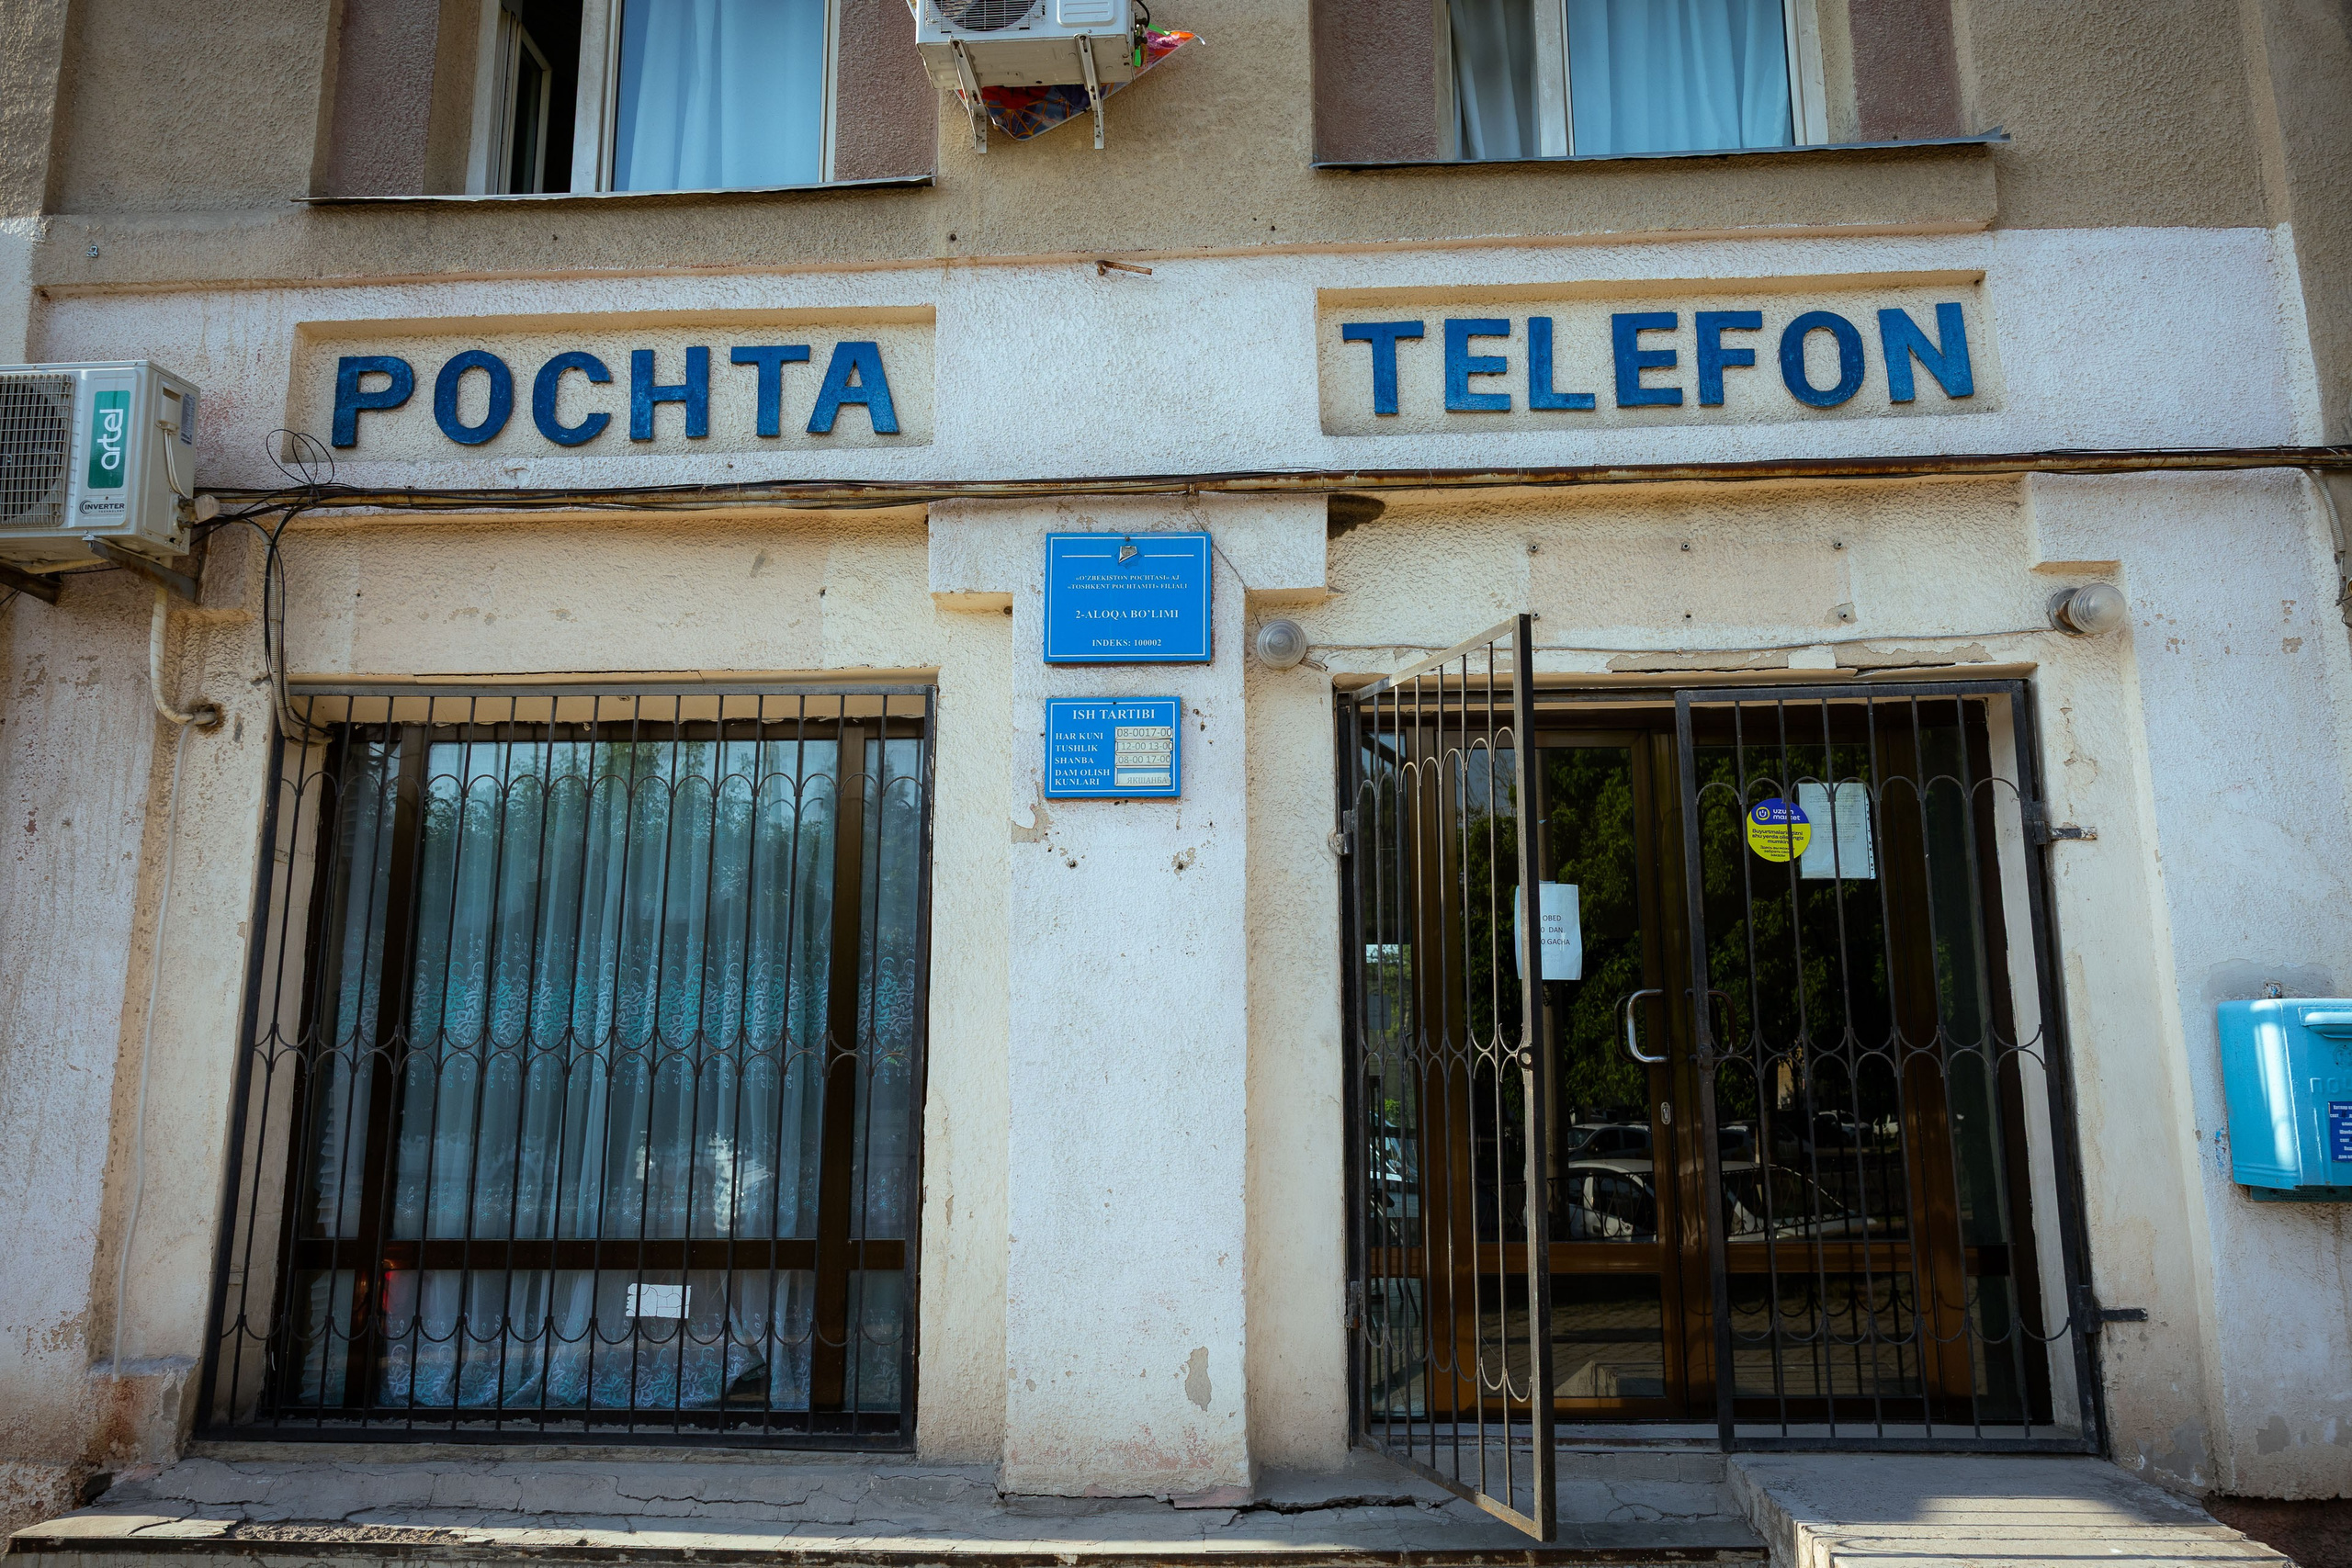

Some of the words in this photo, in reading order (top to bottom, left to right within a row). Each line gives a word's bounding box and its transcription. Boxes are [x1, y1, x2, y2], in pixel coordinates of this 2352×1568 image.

[1342, 302, 1974, 417] TELEFON
[331, 341, 900, 448] POCHTA
[96, 409, 124, 470] artel
[1075, 609, 1127, 620] 2-ALOQA
[1130, 609, 1179, 618] BO'LIMI
[1134, 638, 1161, 647] 100002
[1073, 709, 1095, 719] ISH
[1100, 709, 1155, 719] TARTIBI
[1055, 732, 1076, 740] HAR
[1055, 744, 1098, 752] TUSHLIK
[1122, 741, 1146, 750] 12-00
[1118, 755, 1143, 763] 08-00
[1146, 755, 1171, 763] 17-00
[1126, 776, 1168, 784] ЯКШАНБА
